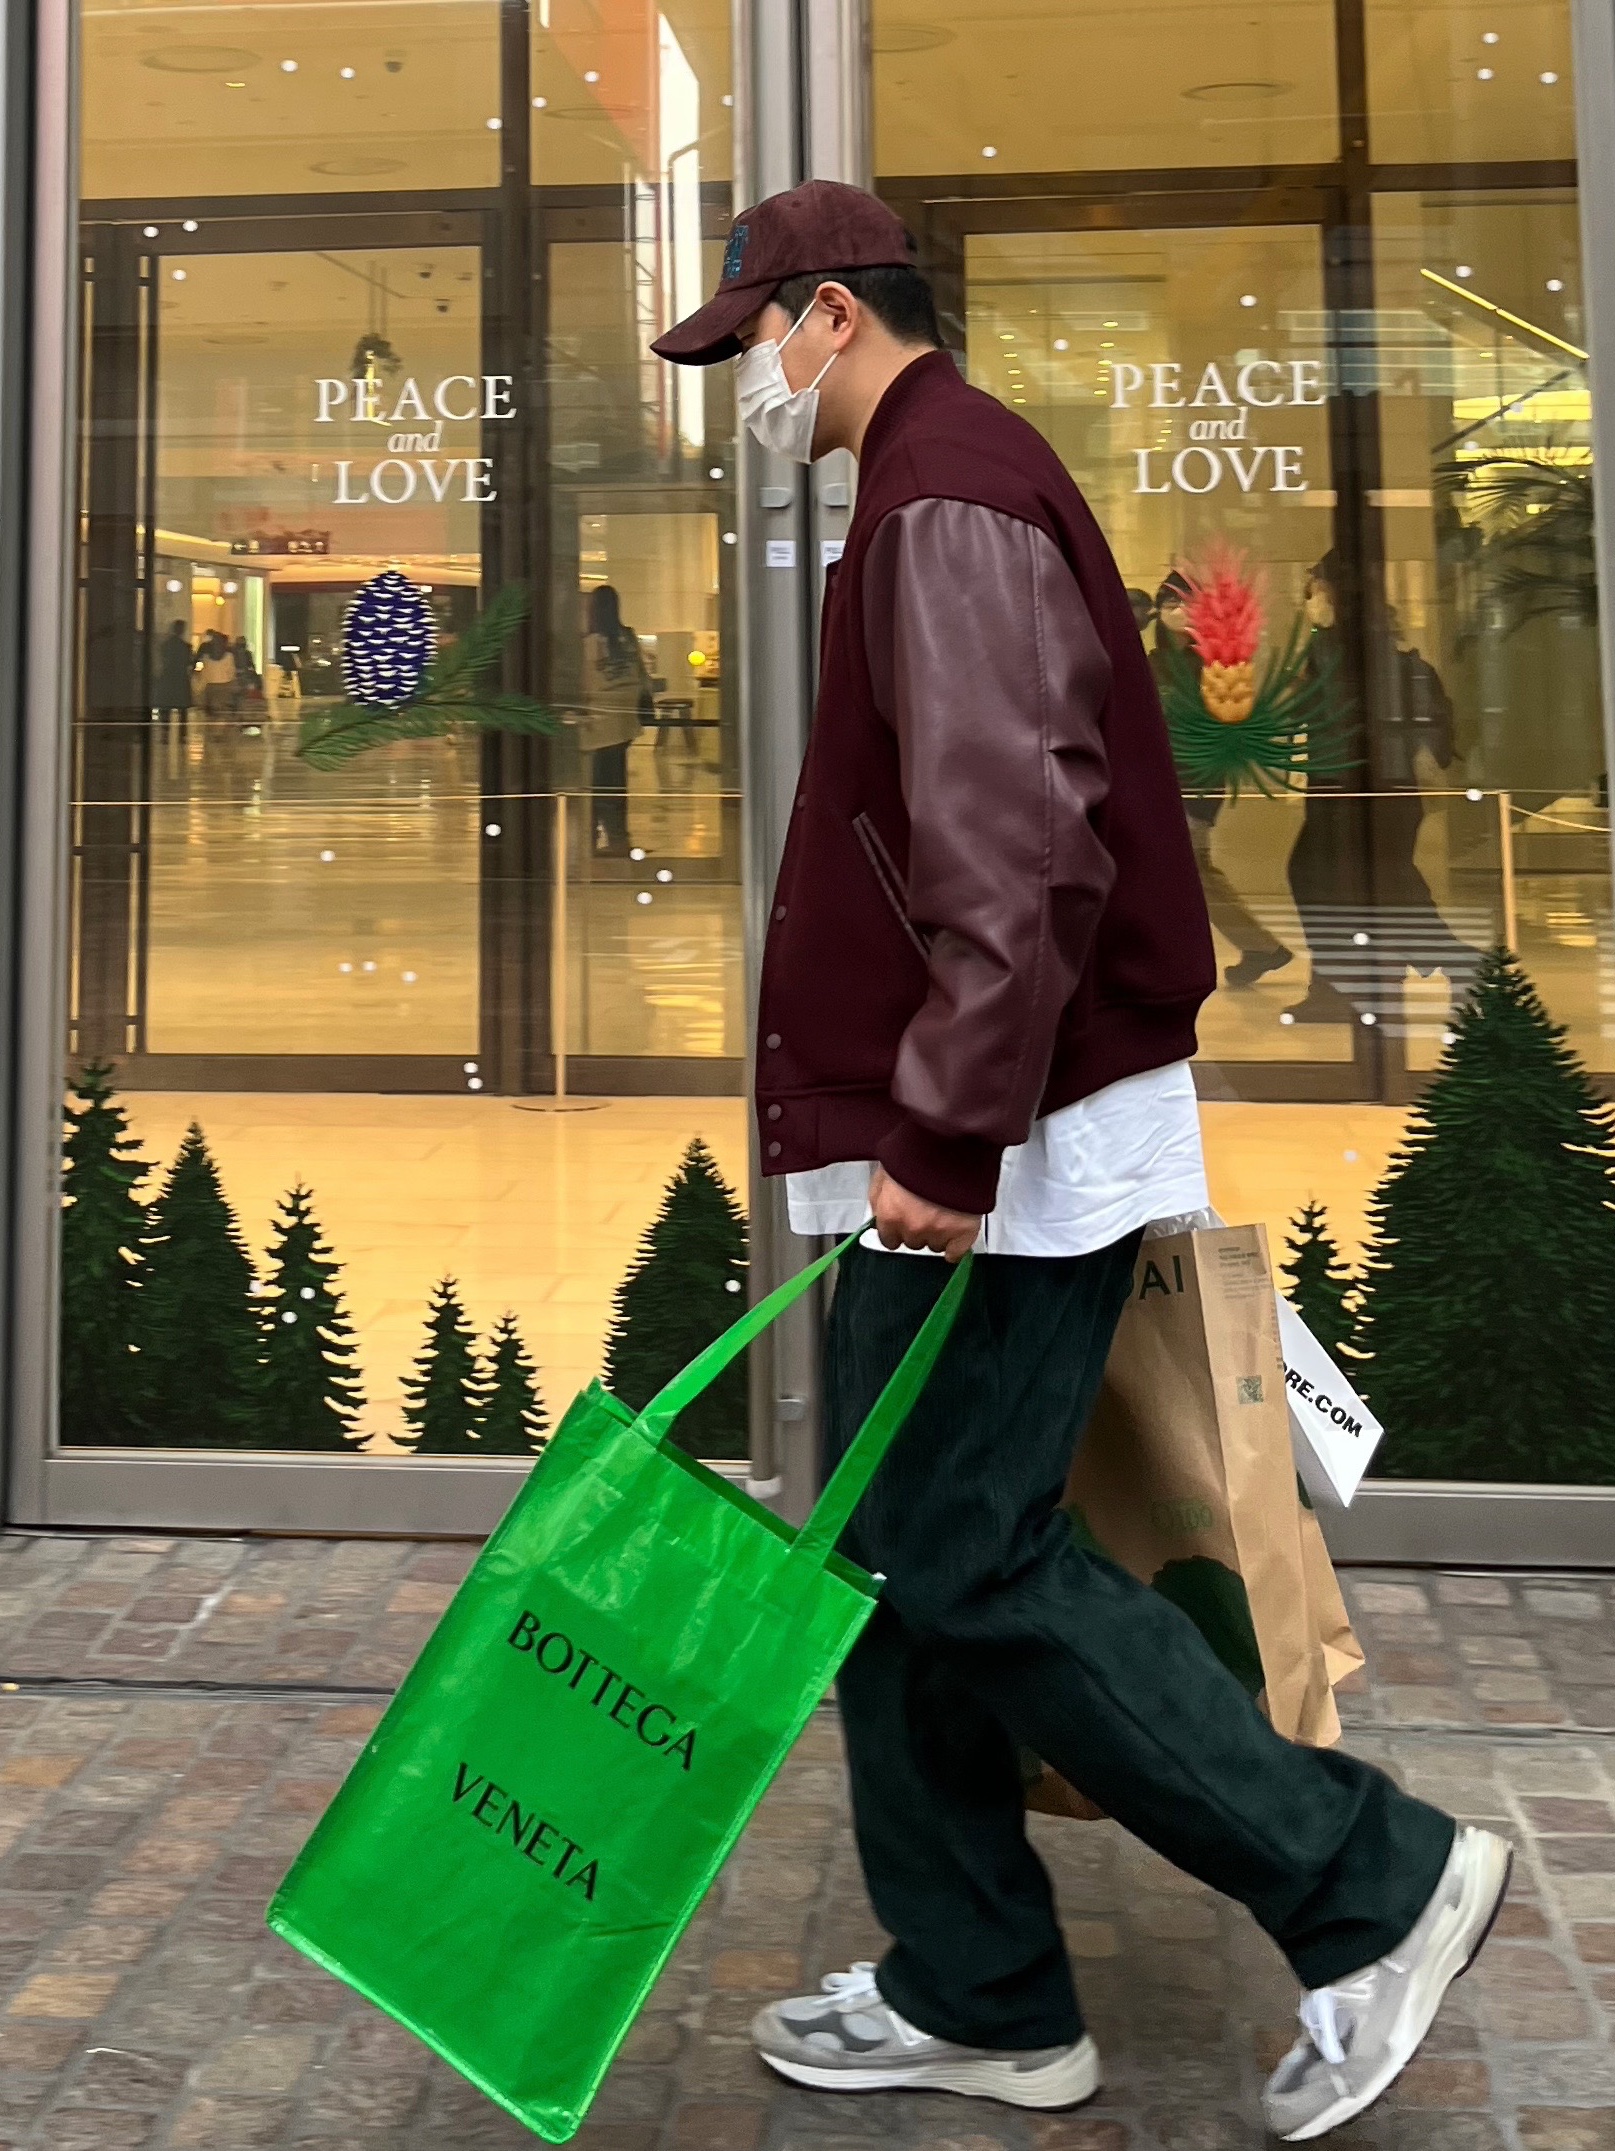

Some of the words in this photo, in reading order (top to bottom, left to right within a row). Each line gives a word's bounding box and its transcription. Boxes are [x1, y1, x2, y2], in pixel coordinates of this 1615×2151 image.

[313, 376, 517, 422] PEACE
[1109, 360, 1327, 408] PEACE
[387, 420, 444, 453] and
[1189, 407, 1249, 441] and
[332, 458, 498, 504] LOVE
[1131, 446, 1309, 493] LOVE
[1283, 1360, 1363, 1438] RE.COM
[506, 1610, 697, 1772] BOTTEGA
[451, 1761, 599, 1901] VENETA
